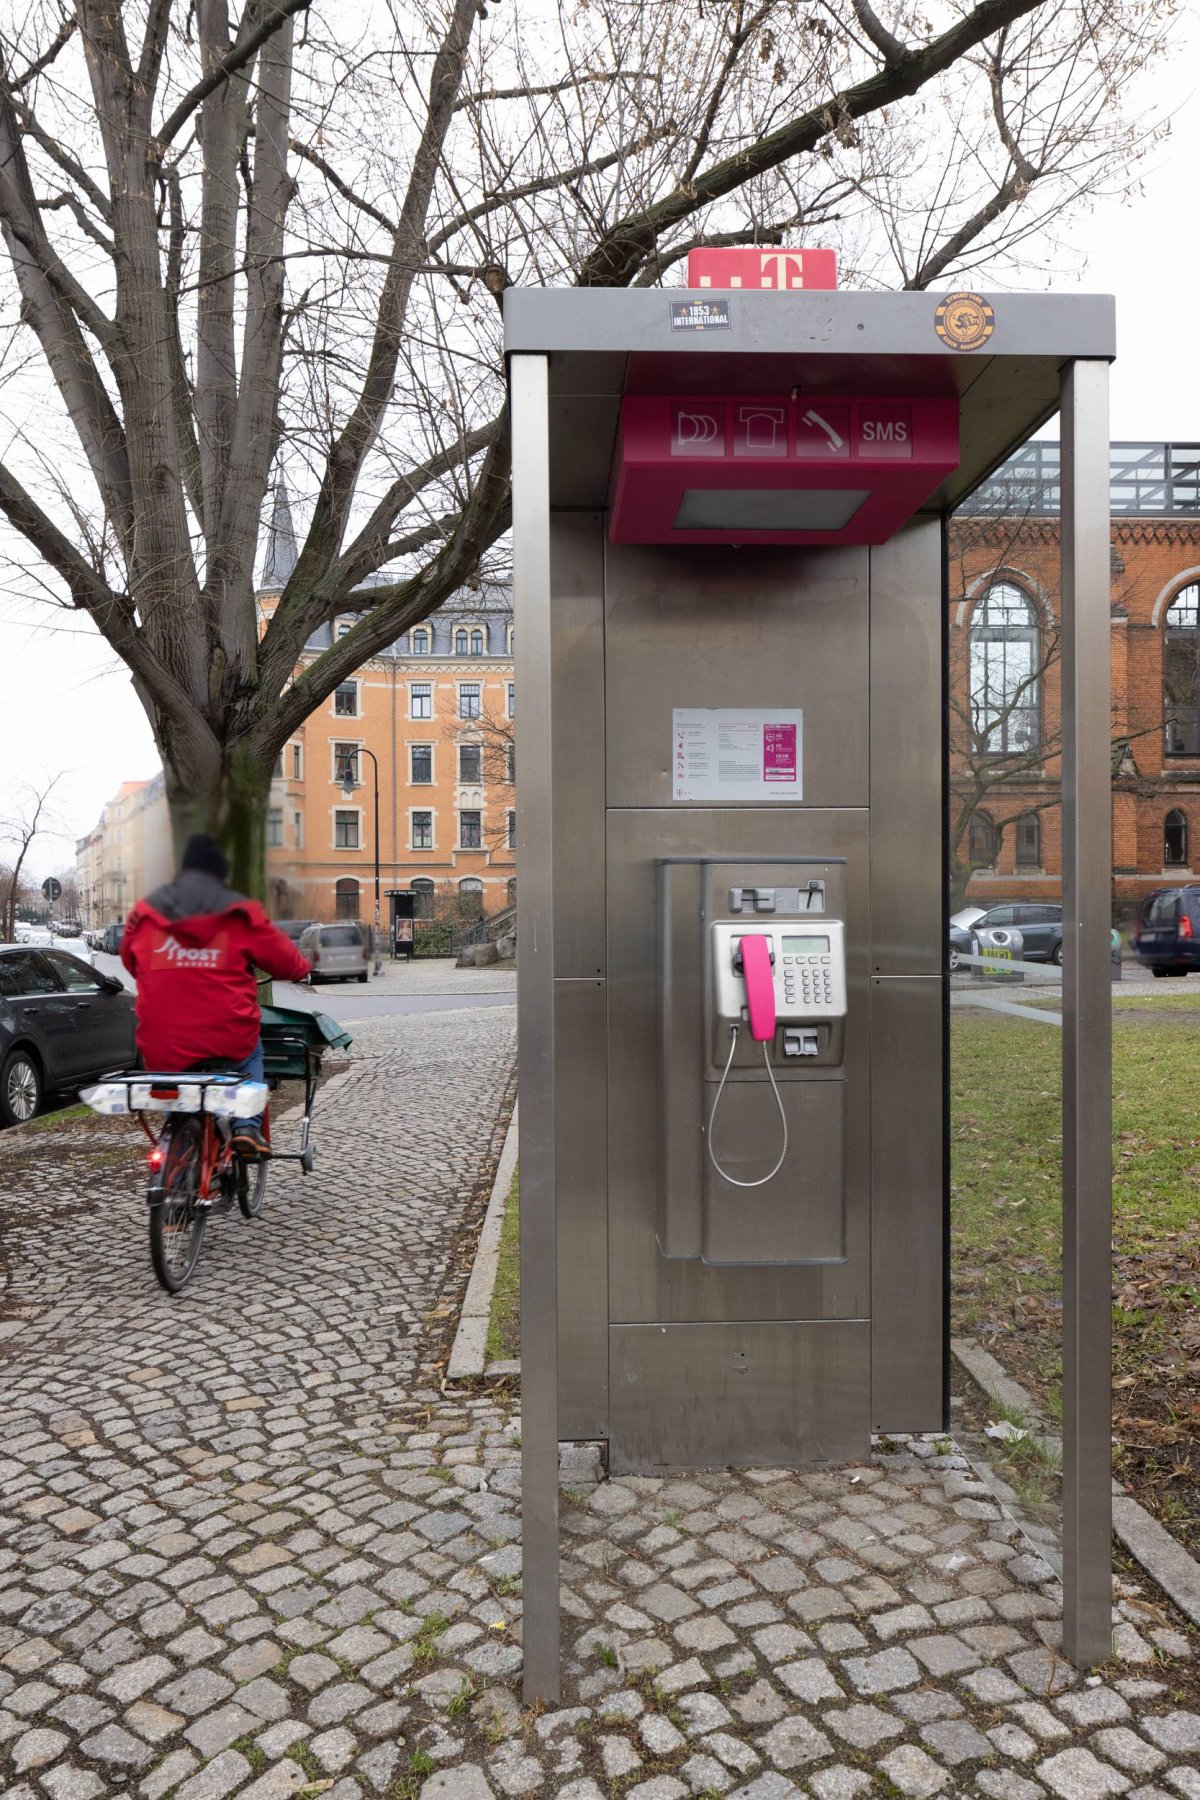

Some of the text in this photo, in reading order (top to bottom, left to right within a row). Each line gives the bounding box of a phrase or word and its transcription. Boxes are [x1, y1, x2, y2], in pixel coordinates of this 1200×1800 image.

[760, 253, 803, 290] T
[689, 305, 710, 317] 1953
[673, 314, 729, 327] INTERNATIONAL
[862, 421, 908, 442] SMS
[177, 948, 219, 961] POST
